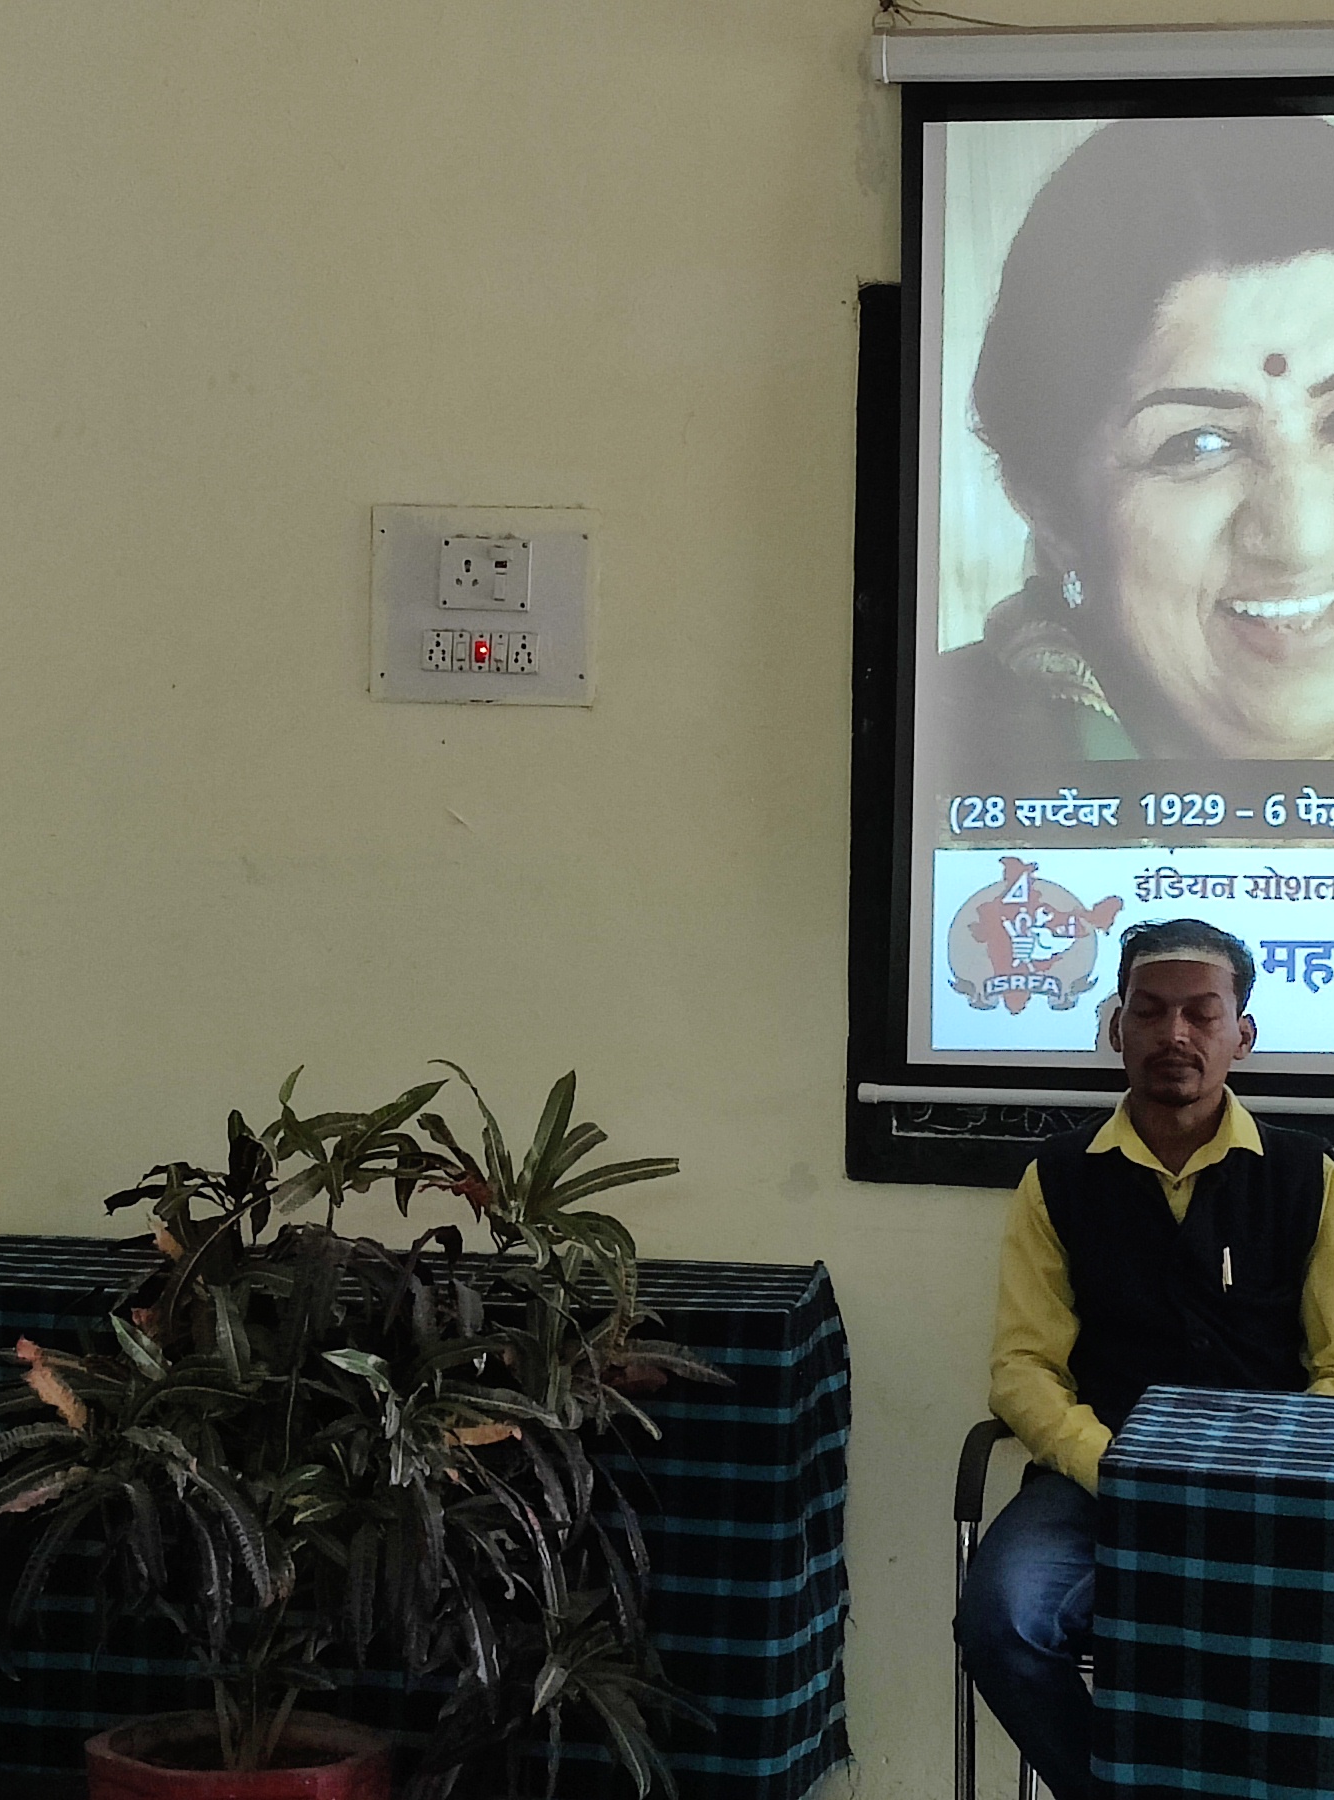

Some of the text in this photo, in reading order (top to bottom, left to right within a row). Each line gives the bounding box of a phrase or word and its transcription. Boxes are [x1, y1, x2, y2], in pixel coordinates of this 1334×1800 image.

[948, 794, 1007, 833] (28
[1015, 788, 1121, 828] सप्टेंबर
[1141, 792, 1227, 828] 1929
[1264, 793, 1288, 828] 6
[1134, 866, 1239, 902] इंडियन
[986, 974, 1060, 995] ISRFA
